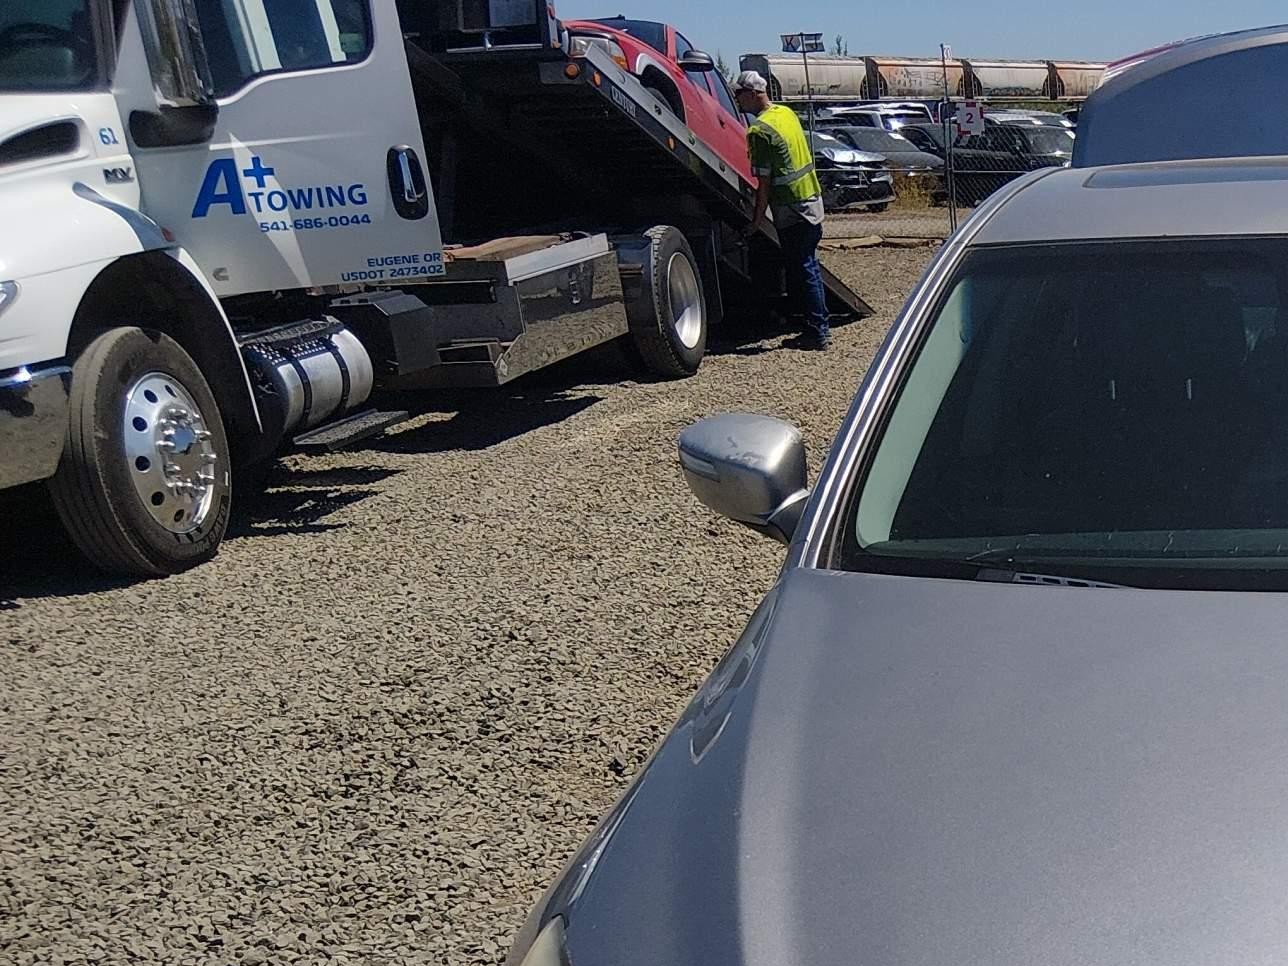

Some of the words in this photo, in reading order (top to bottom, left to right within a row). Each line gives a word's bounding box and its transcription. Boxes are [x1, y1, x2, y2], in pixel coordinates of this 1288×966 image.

[966, 112, 974, 124] 2
[99, 127, 119, 145] 61
[191, 156, 274, 218] A+
[248, 184, 368, 212] TOWING
[260, 213, 371, 233] 541-686-0044
[367, 254, 420, 267] EUGENE
[423, 252, 441, 262] OR
[341, 269, 385, 282] USDOT
[389, 264, 444, 278] 2473402
